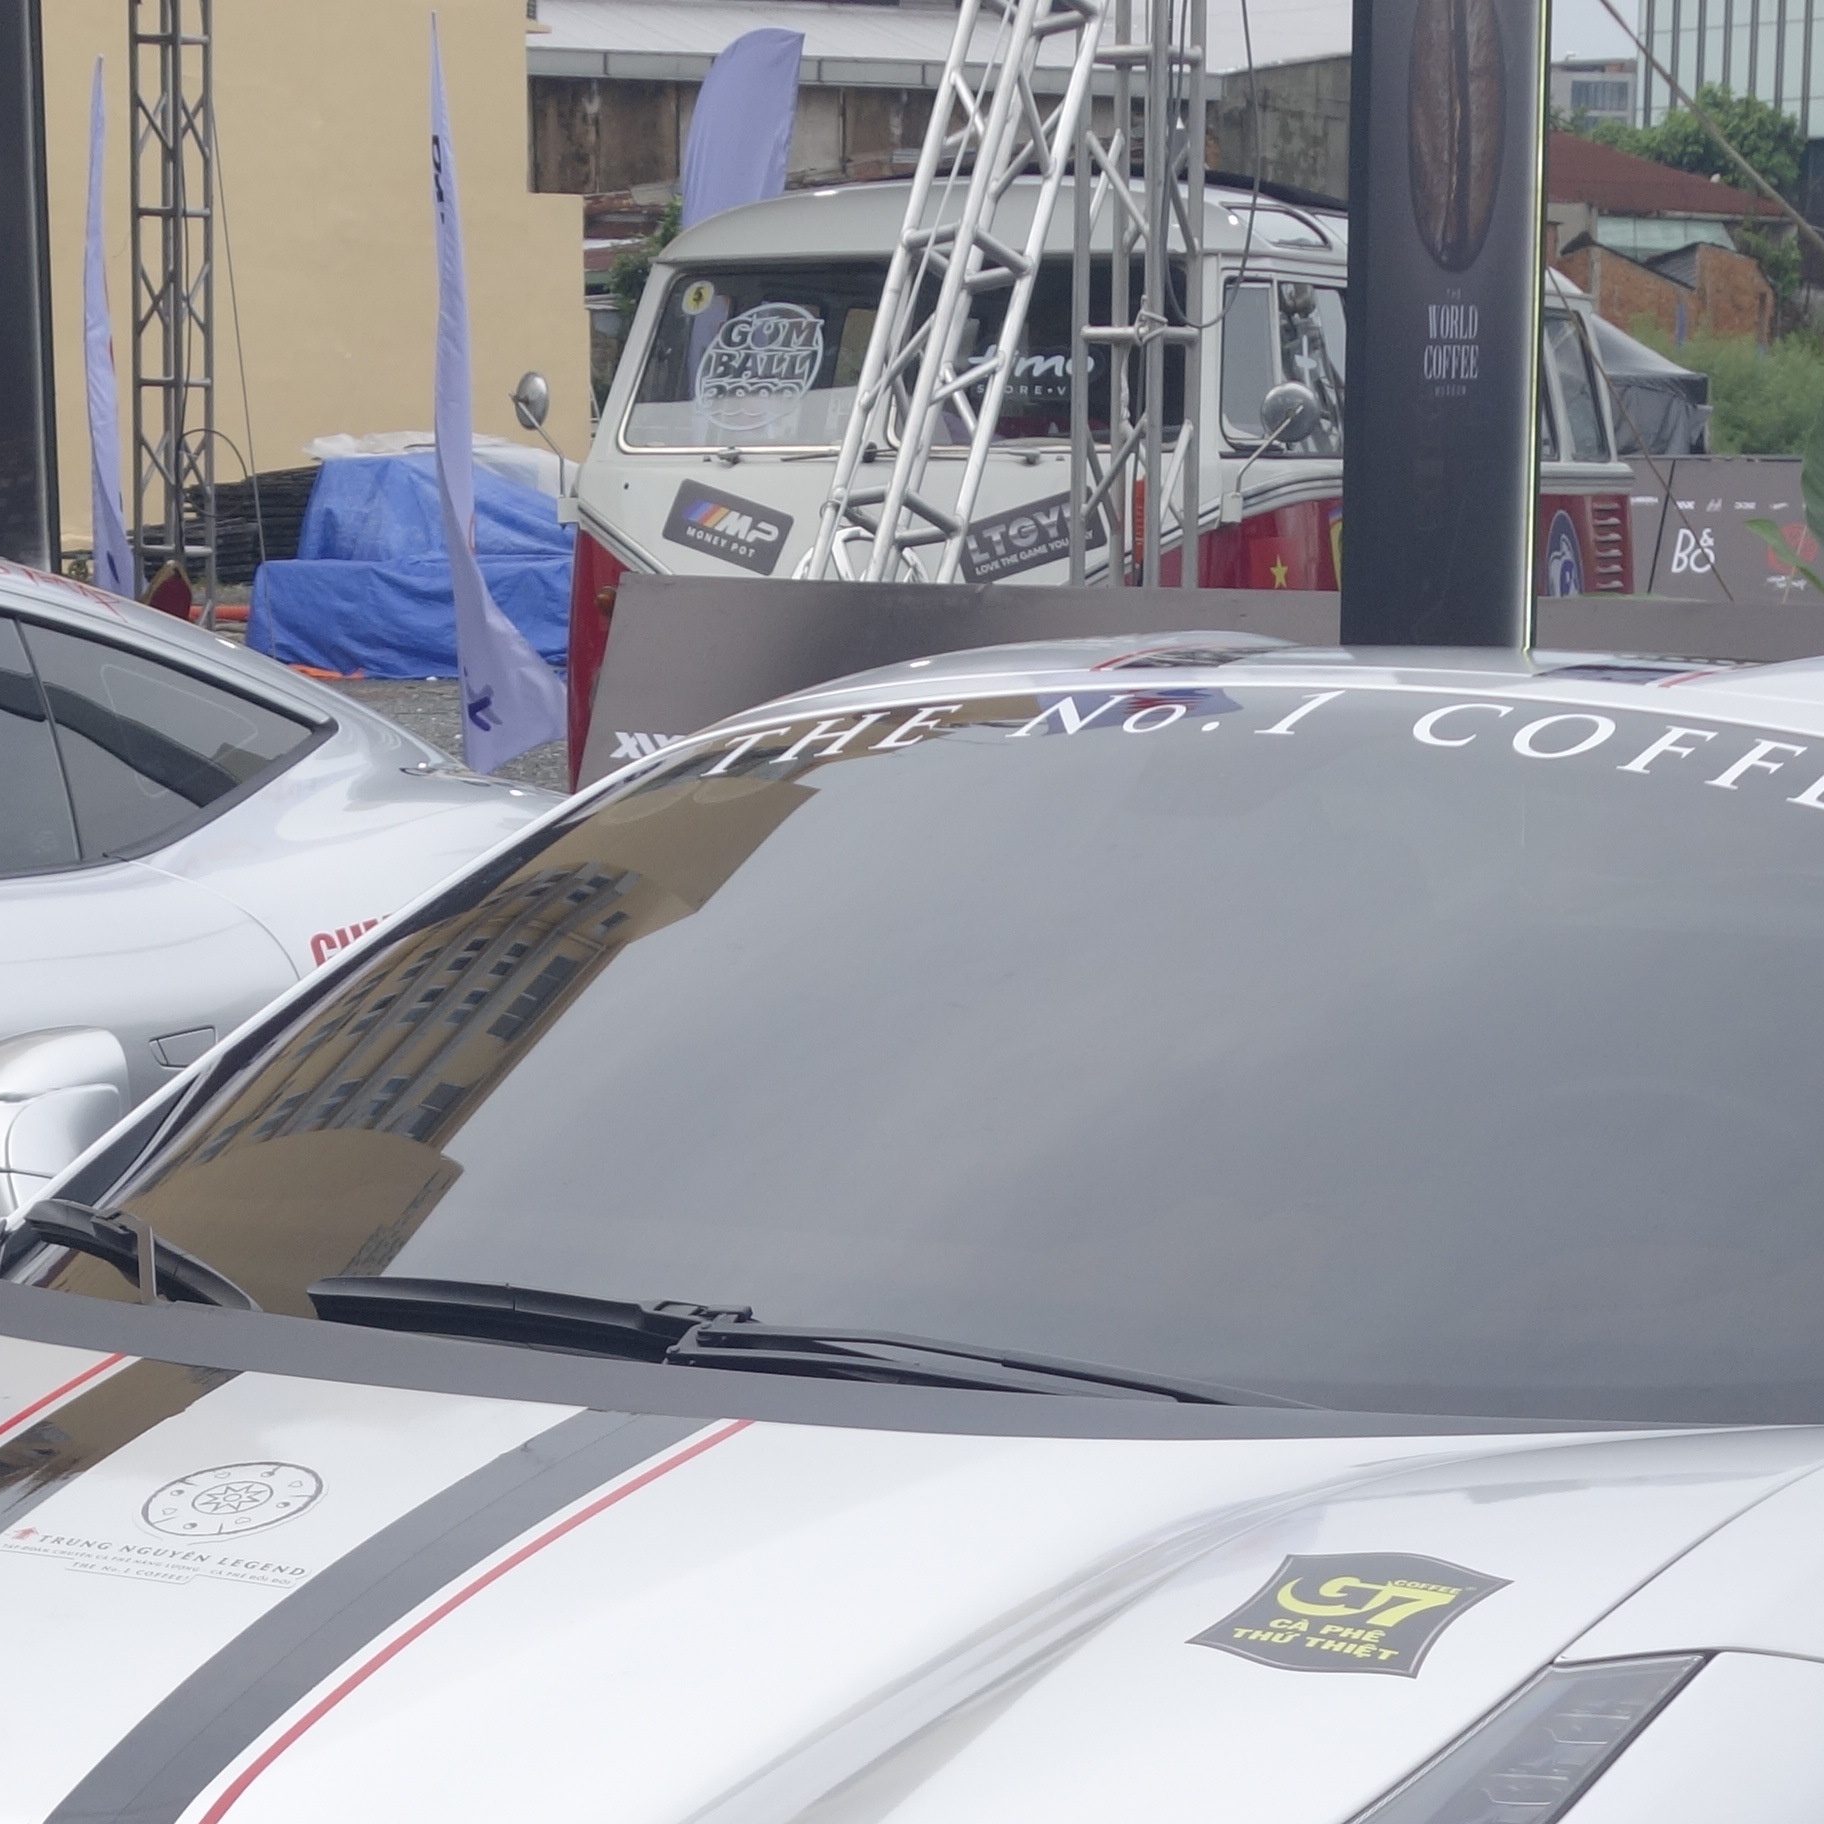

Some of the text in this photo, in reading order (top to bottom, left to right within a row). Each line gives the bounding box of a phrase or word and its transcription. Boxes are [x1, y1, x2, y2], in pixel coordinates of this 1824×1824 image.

[1428, 304, 1479, 340] WORLD
[1423, 344, 1480, 380] COFFEE
[686, 526, 756, 558] MONEY POT
[975, 560, 1000, 577] LOVE
[999, 553, 1019, 568] THE
[1019, 544, 1048, 561] GAME
[701, 704, 964, 779] THE
[39, 1533, 307, 1577] TRUNG NGUYÊN LEGEND
[72, 1561, 96, 1570] THE
[135, 1568, 191, 1582] COFFEE!
[1276, 1576, 1457, 1628] G7
[1393, 1579, 1463, 1596] COFFEE
[1268, 1617, 1388, 1644] CÀ PHÊ
[1304, 1636, 1400, 1662] THIỆT
